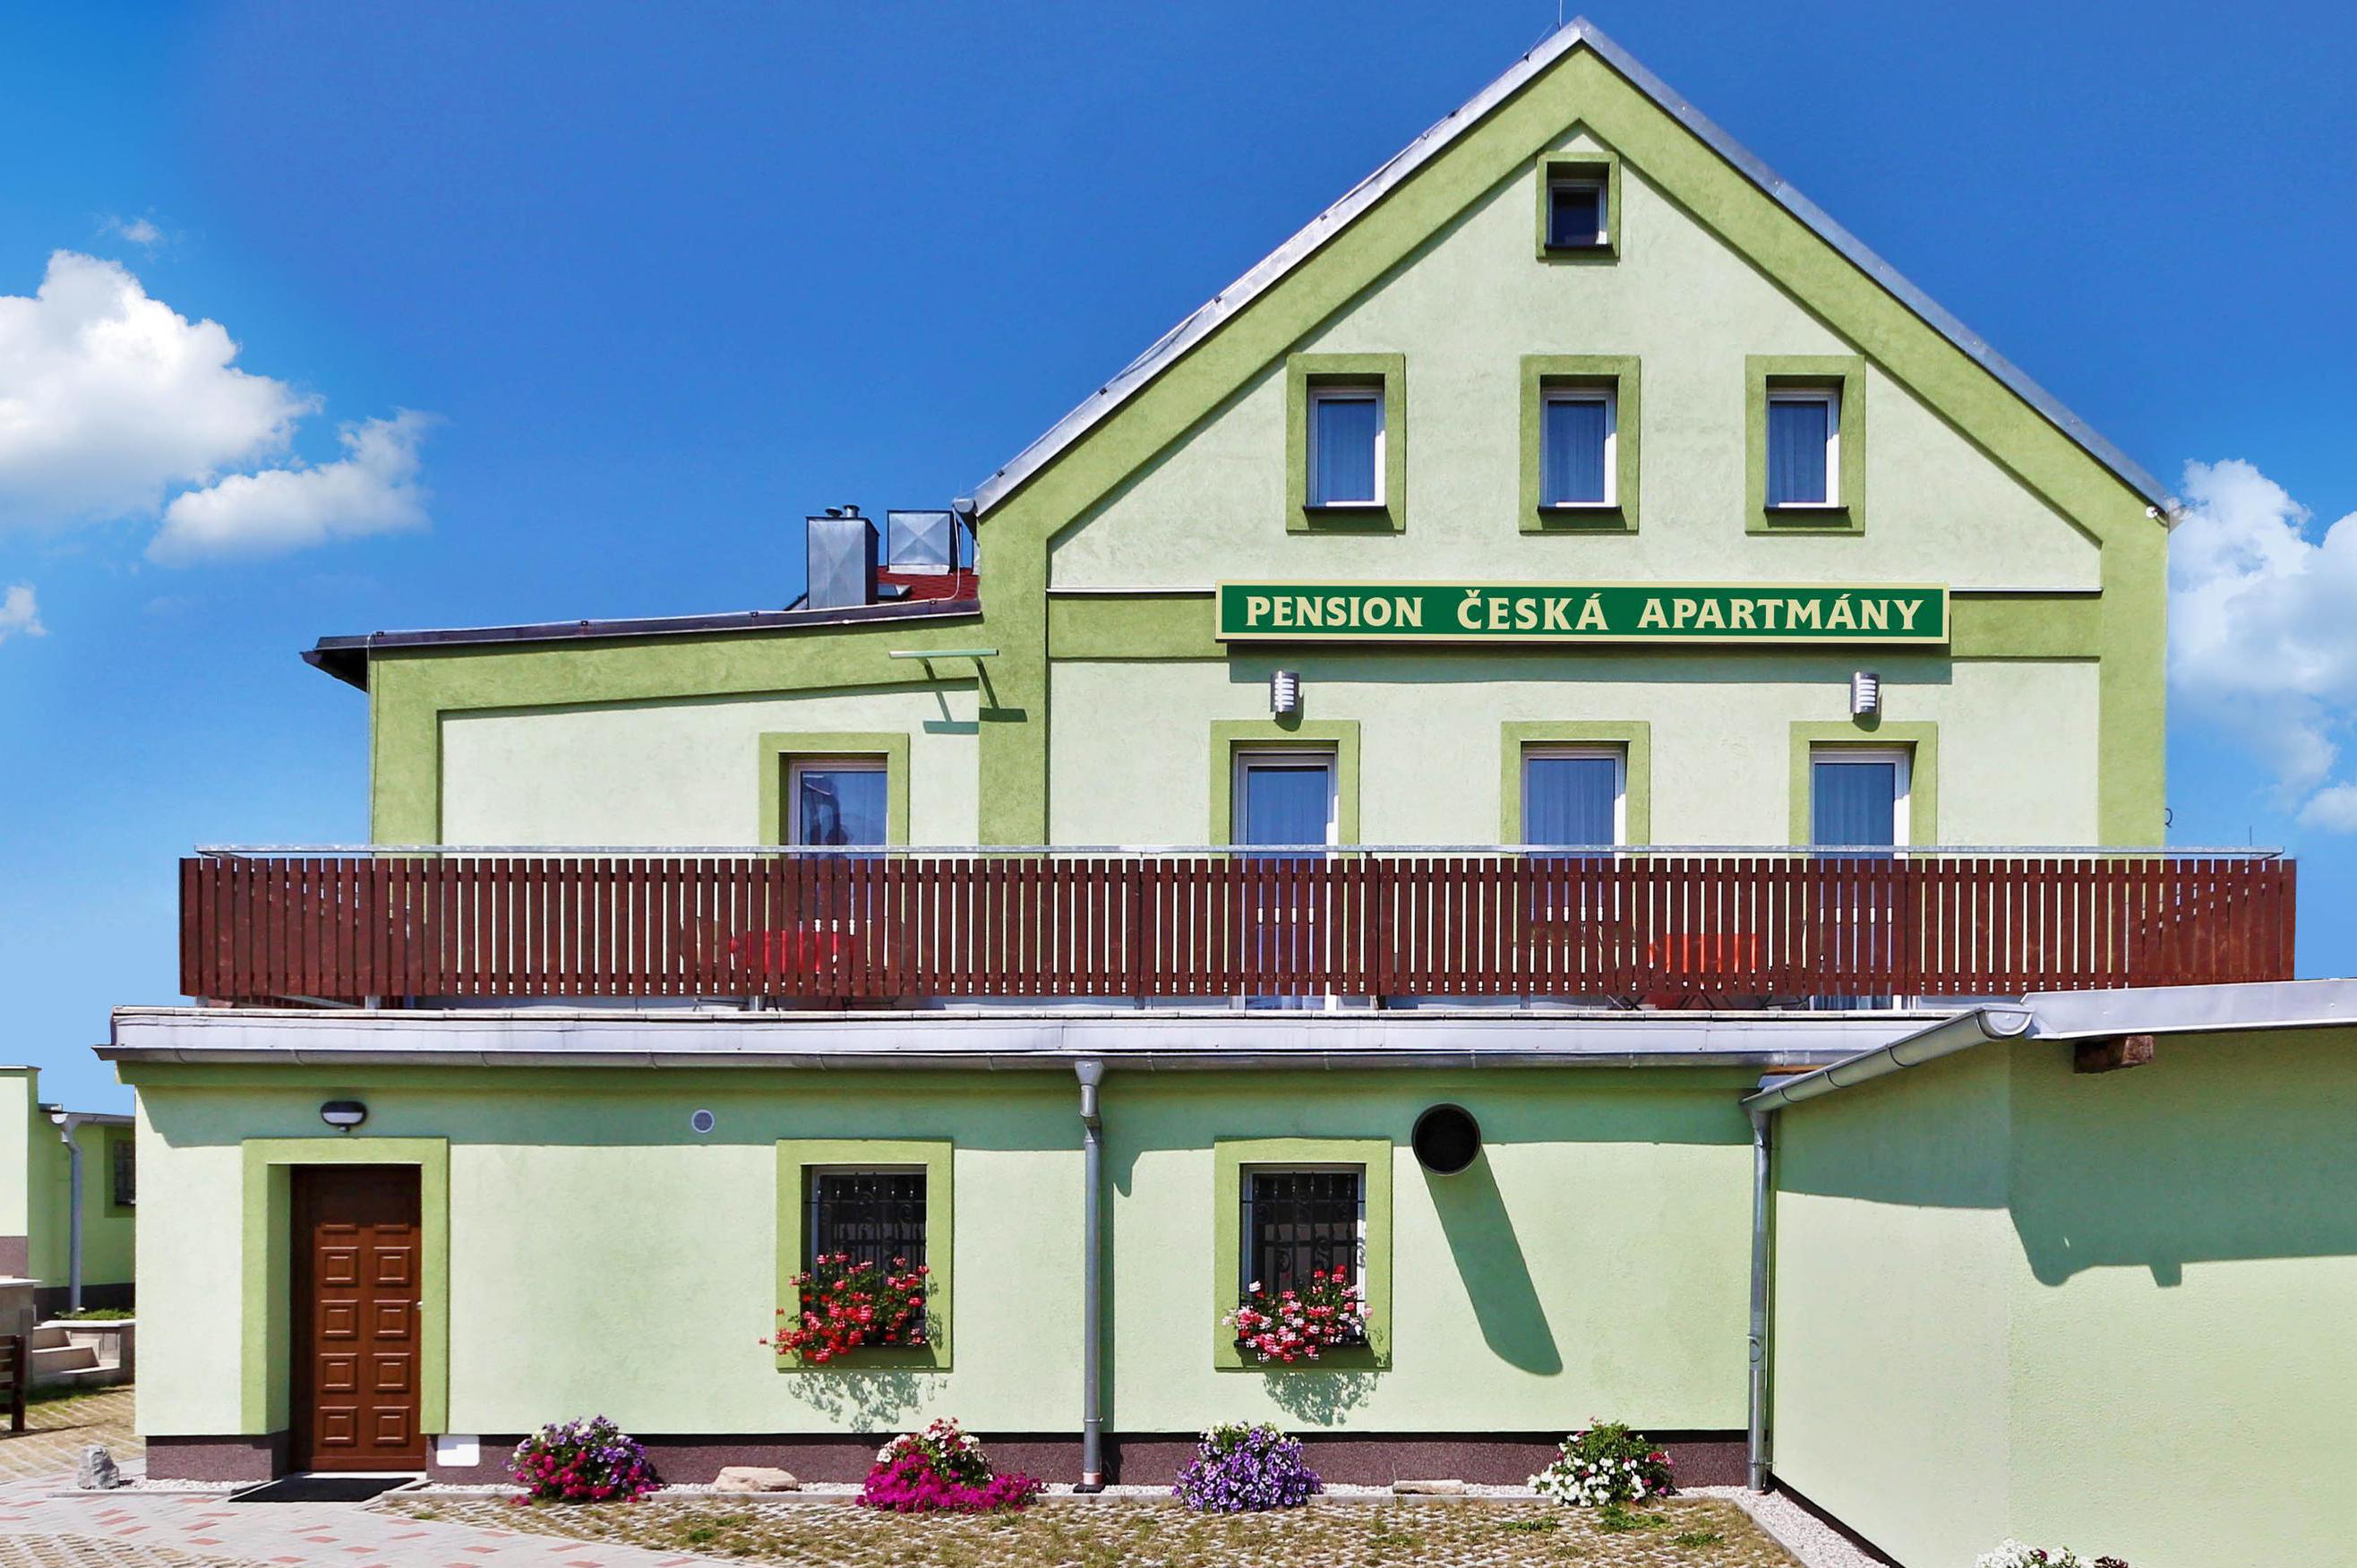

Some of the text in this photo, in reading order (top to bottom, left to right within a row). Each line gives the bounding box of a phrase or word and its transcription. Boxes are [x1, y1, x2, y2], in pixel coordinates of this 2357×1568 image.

[1246, 589, 1924, 630] PENSION ČESKÁ APARTMÁNY
